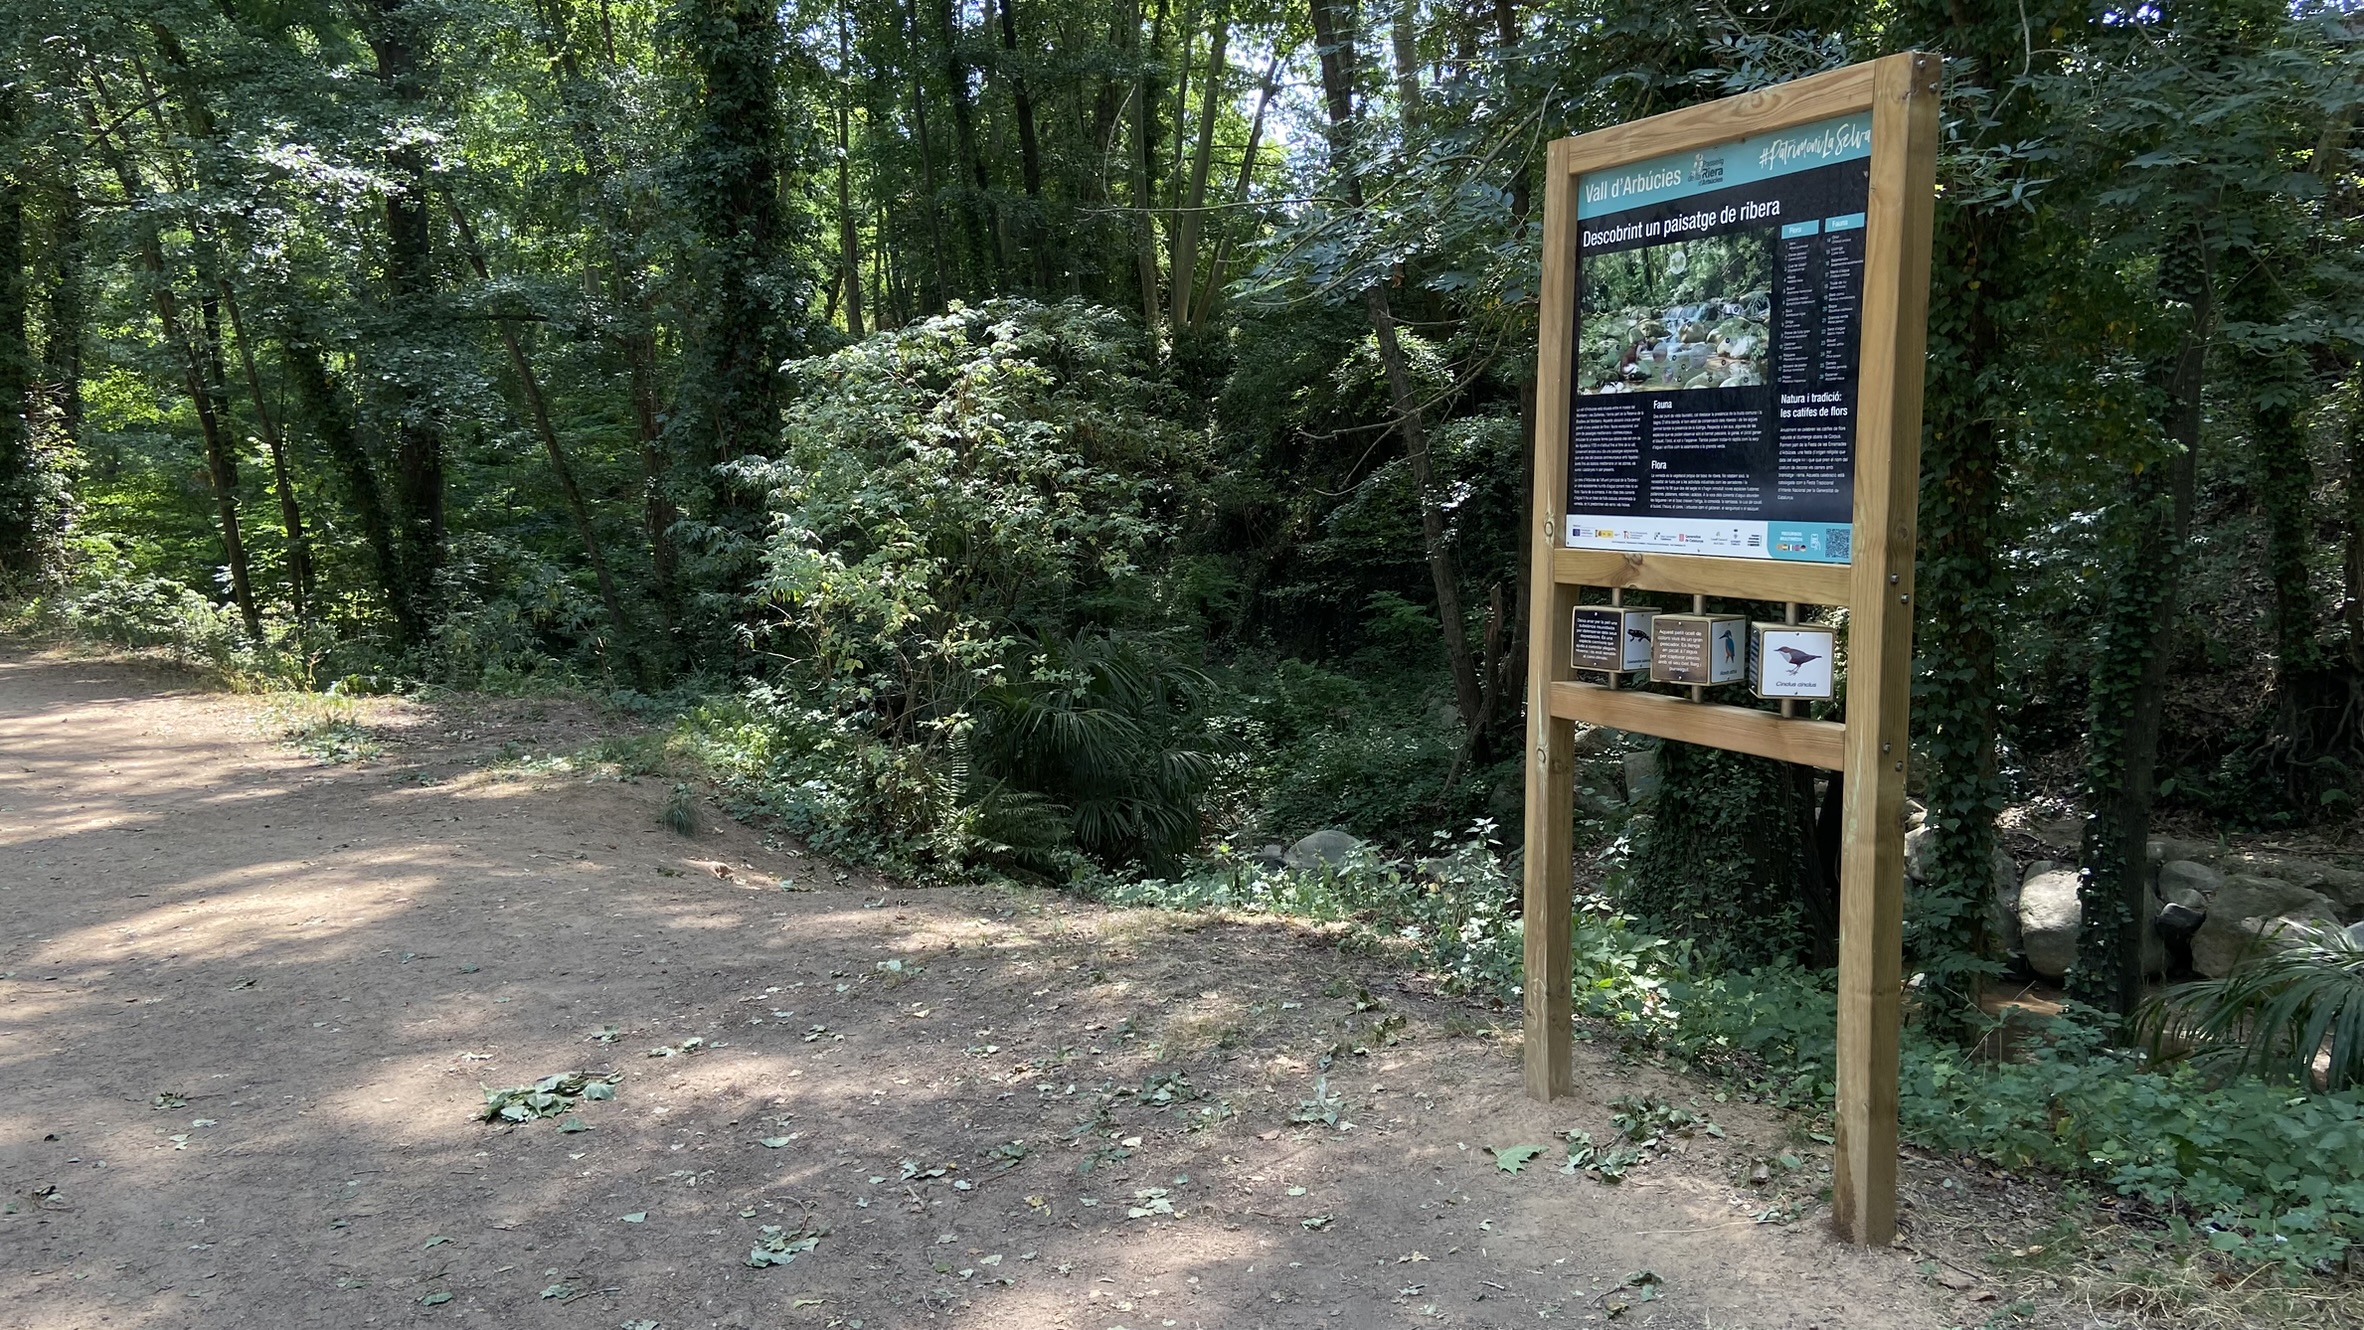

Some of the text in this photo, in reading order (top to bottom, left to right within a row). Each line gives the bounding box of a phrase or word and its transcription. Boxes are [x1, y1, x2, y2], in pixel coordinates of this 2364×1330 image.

[1702, 167, 1723, 178] Riera
[1585, 168, 1682, 203] Vall d'Arbúcies
[1583, 200, 1780, 248] Descobrint un paisatge de ribera
[1831, 219, 1848, 228] Fauna
[1780, 391, 1842, 404] Natura i tradició:
[1653, 400, 1673, 409] Fauna
[1780, 406, 1848, 418] les catifes de flors
[1651, 460, 1667, 470] Flora
